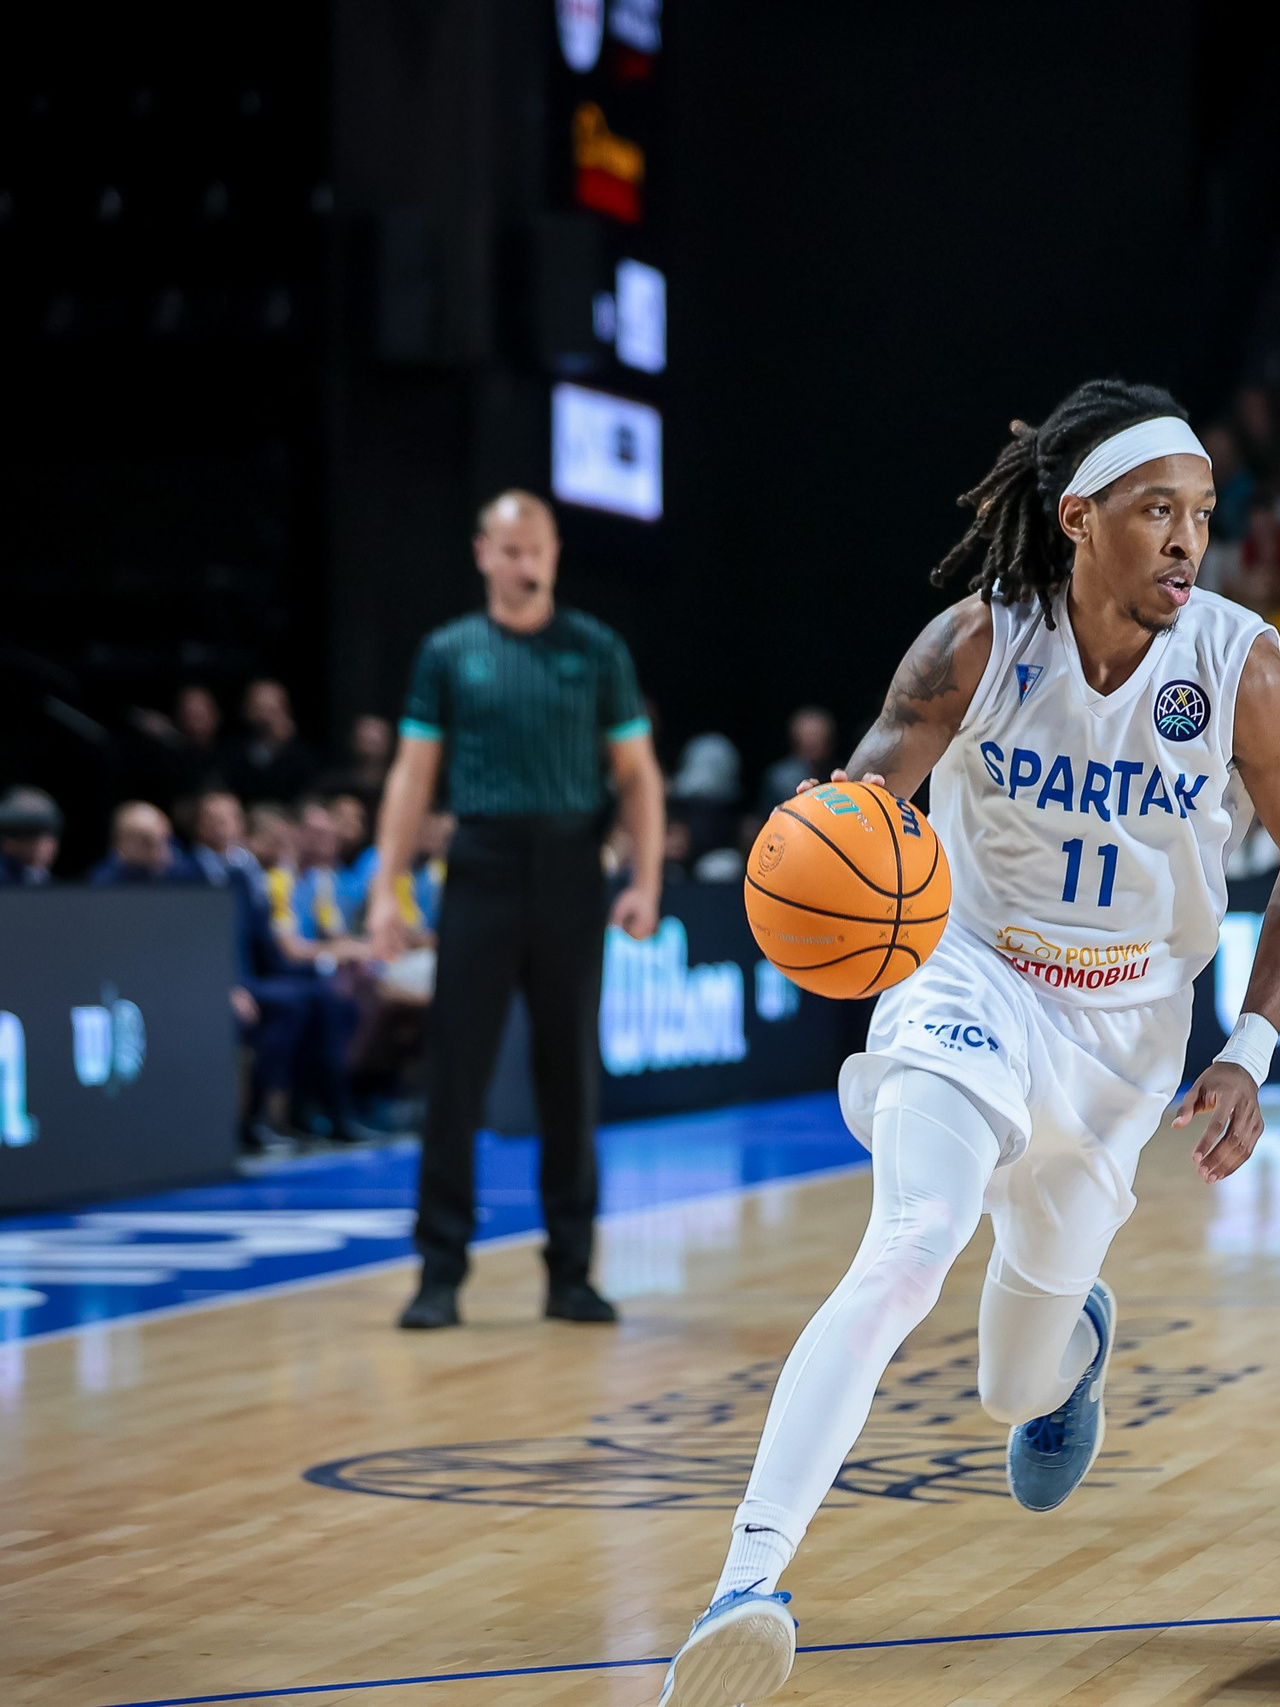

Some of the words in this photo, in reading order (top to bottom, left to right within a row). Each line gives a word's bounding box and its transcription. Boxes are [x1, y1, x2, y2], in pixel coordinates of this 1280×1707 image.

[980, 740, 1209, 822] SPARTAK
[1061, 838, 1118, 908] 11
[1007, 957, 1150, 990] UTOMOBILI
